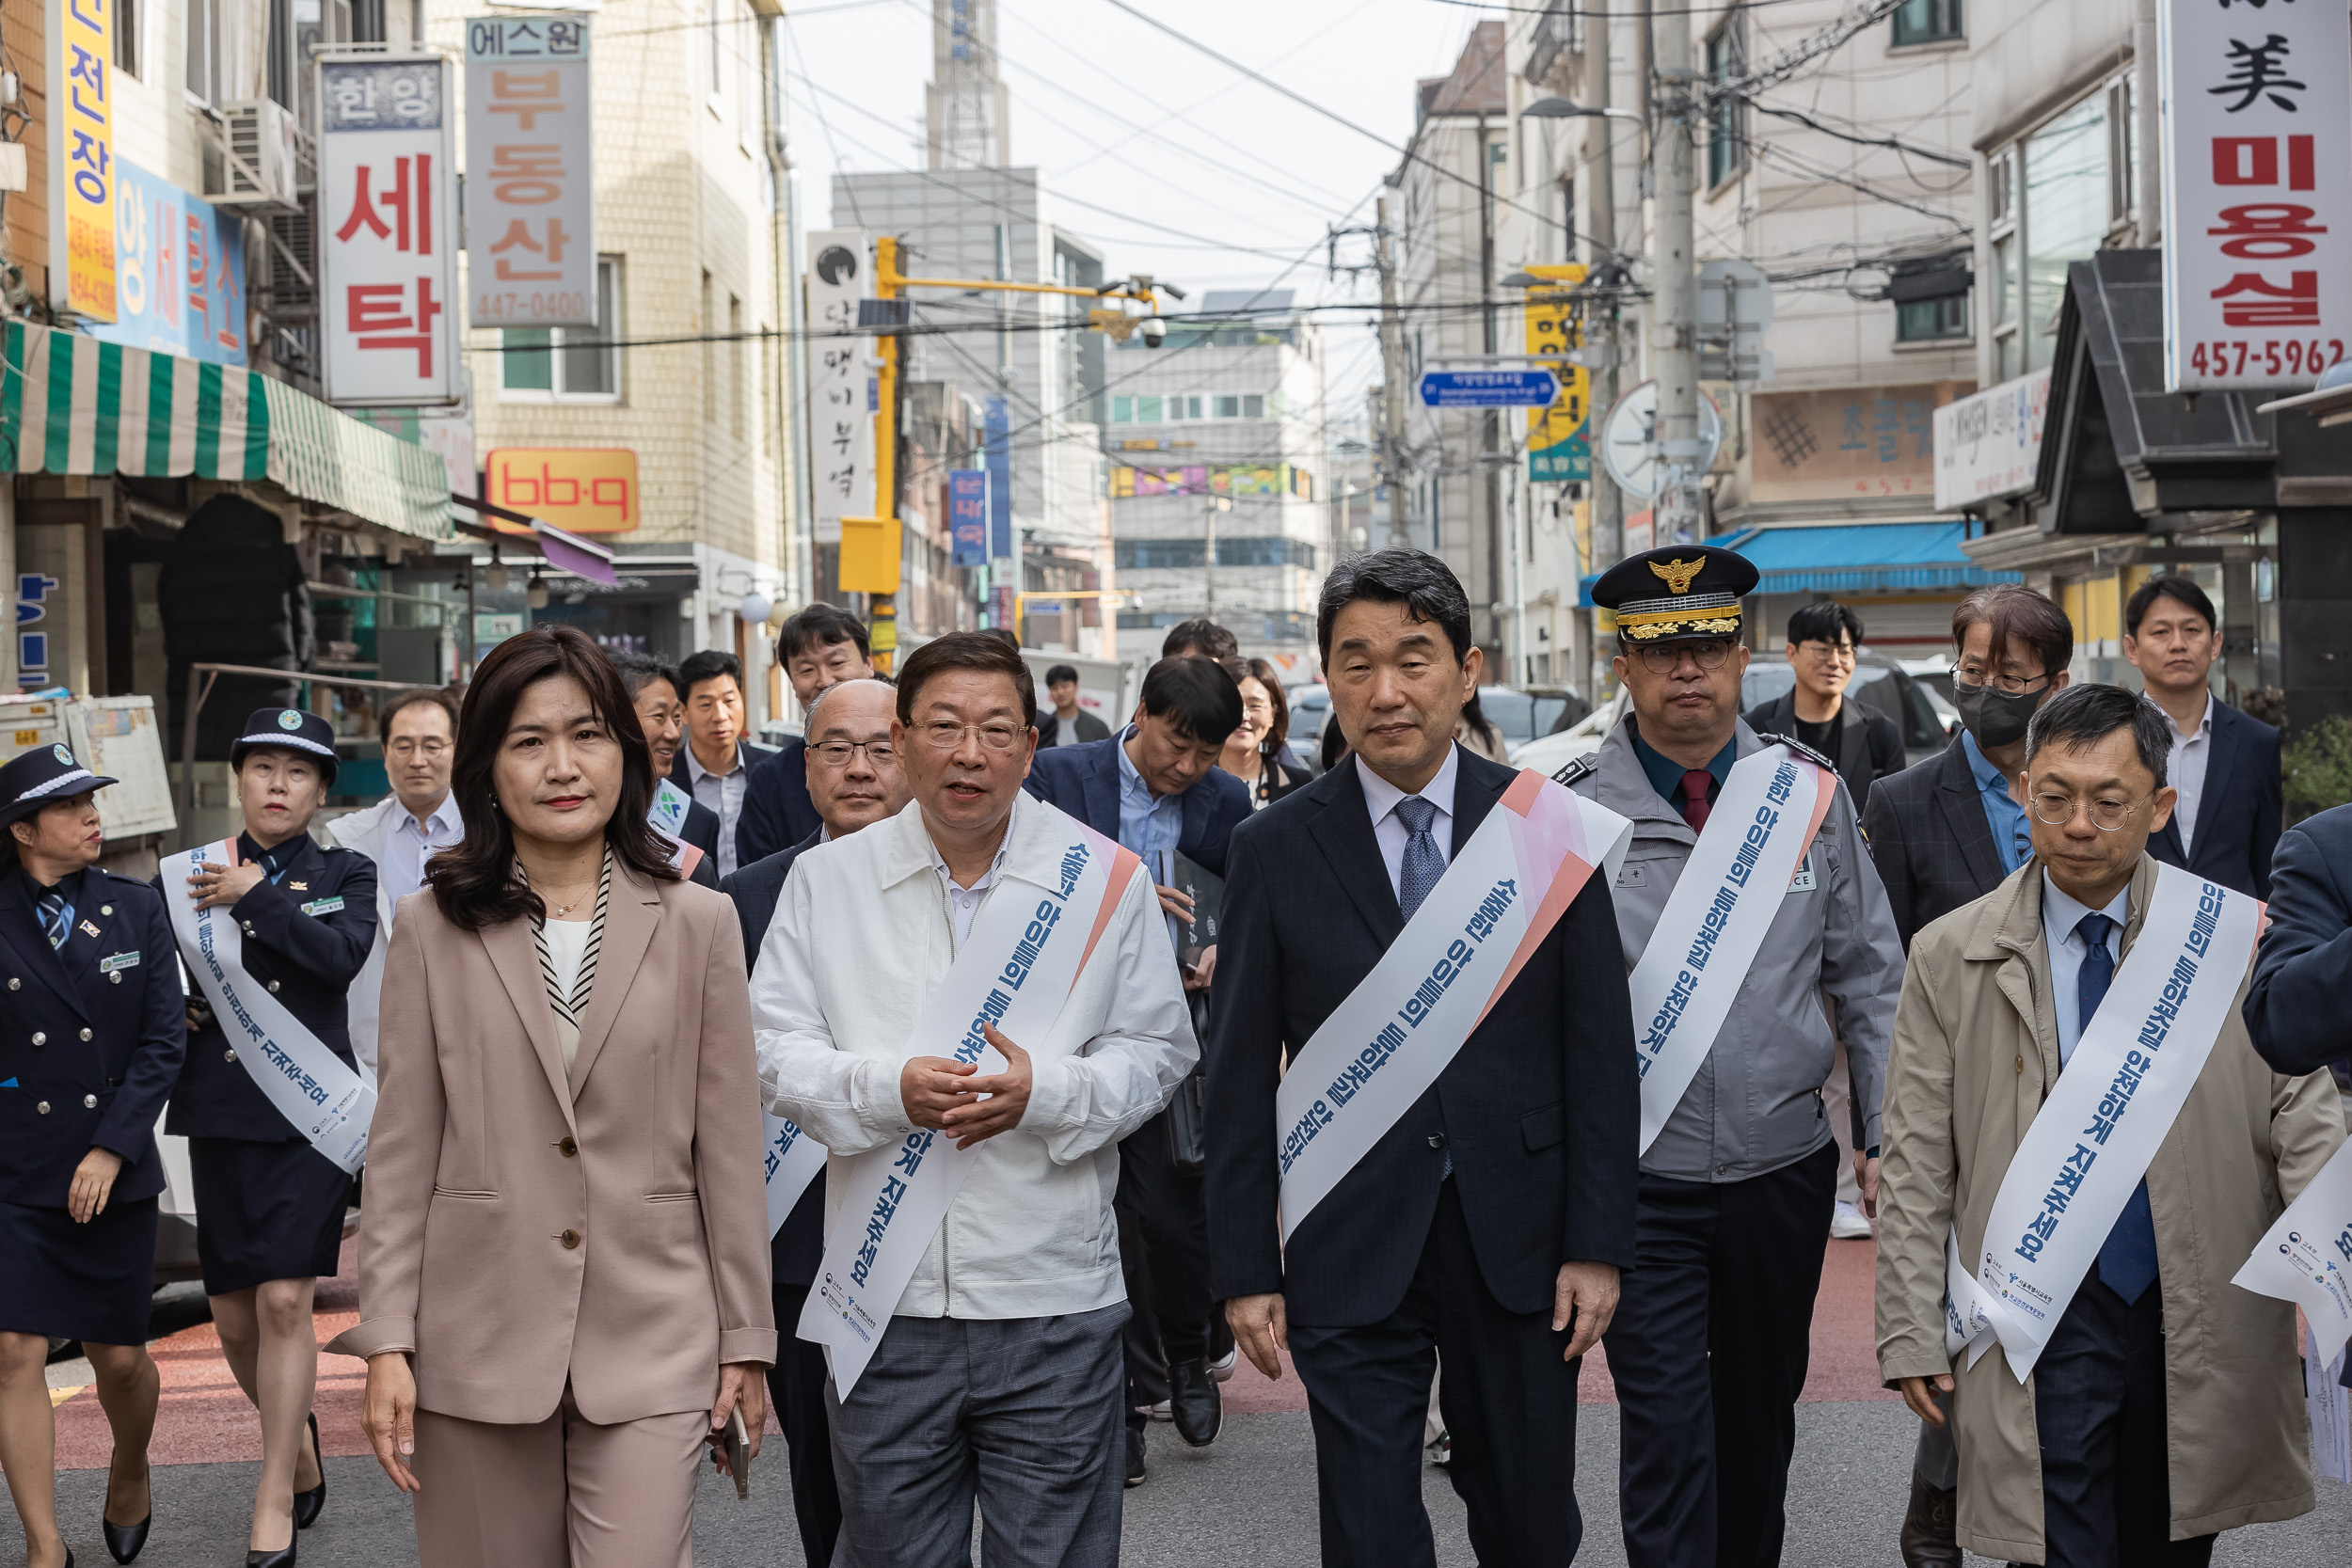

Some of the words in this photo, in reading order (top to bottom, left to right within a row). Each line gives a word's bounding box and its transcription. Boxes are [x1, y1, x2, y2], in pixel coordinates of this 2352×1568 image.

[471, 22, 581, 56] 에스원
[334, 75, 435, 120] 한양
[487, 70, 570, 281] 부동산
[336, 153, 441, 377] 세탁
[2207, 135, 2328, 326] 미용실
[477, 293, 586, 320] 447-0400
[2191, 339, 2344, 377] 457-5962
[1766, 761, 1799, 807] 소중한
[1724, 806, 1778, 888] 아이들의
[998, 900, 1062, 991] 아이들의
[1464, 879, 1518, 943] 소중한
[1686, 886, 1739, 972] 등하굣길
[2184, 882, 2226, 959] 아이들의
[953, 989, 1012, 1065] 등하굣
[1398, 939, 1475, 1029] 아이들의
[1640, 970, 1698, 1055] 안전하게
[2137, 954, 2199, 1053] 등하굣길
[221, 981, 265, 1043] 안전하게
[261, 1038, 329, 1106] 지켜주세요
[1325, 1022, 1407, 1109] 등하굣길
[1279, 1100, 1335, 1176] 안전하게
[2082, 1049, 2152, 1147] 안전하게
[850, 1174, 908, 1289] 지켜주세요
[2014, 1142, 2098, 1264] 지켜주세요
